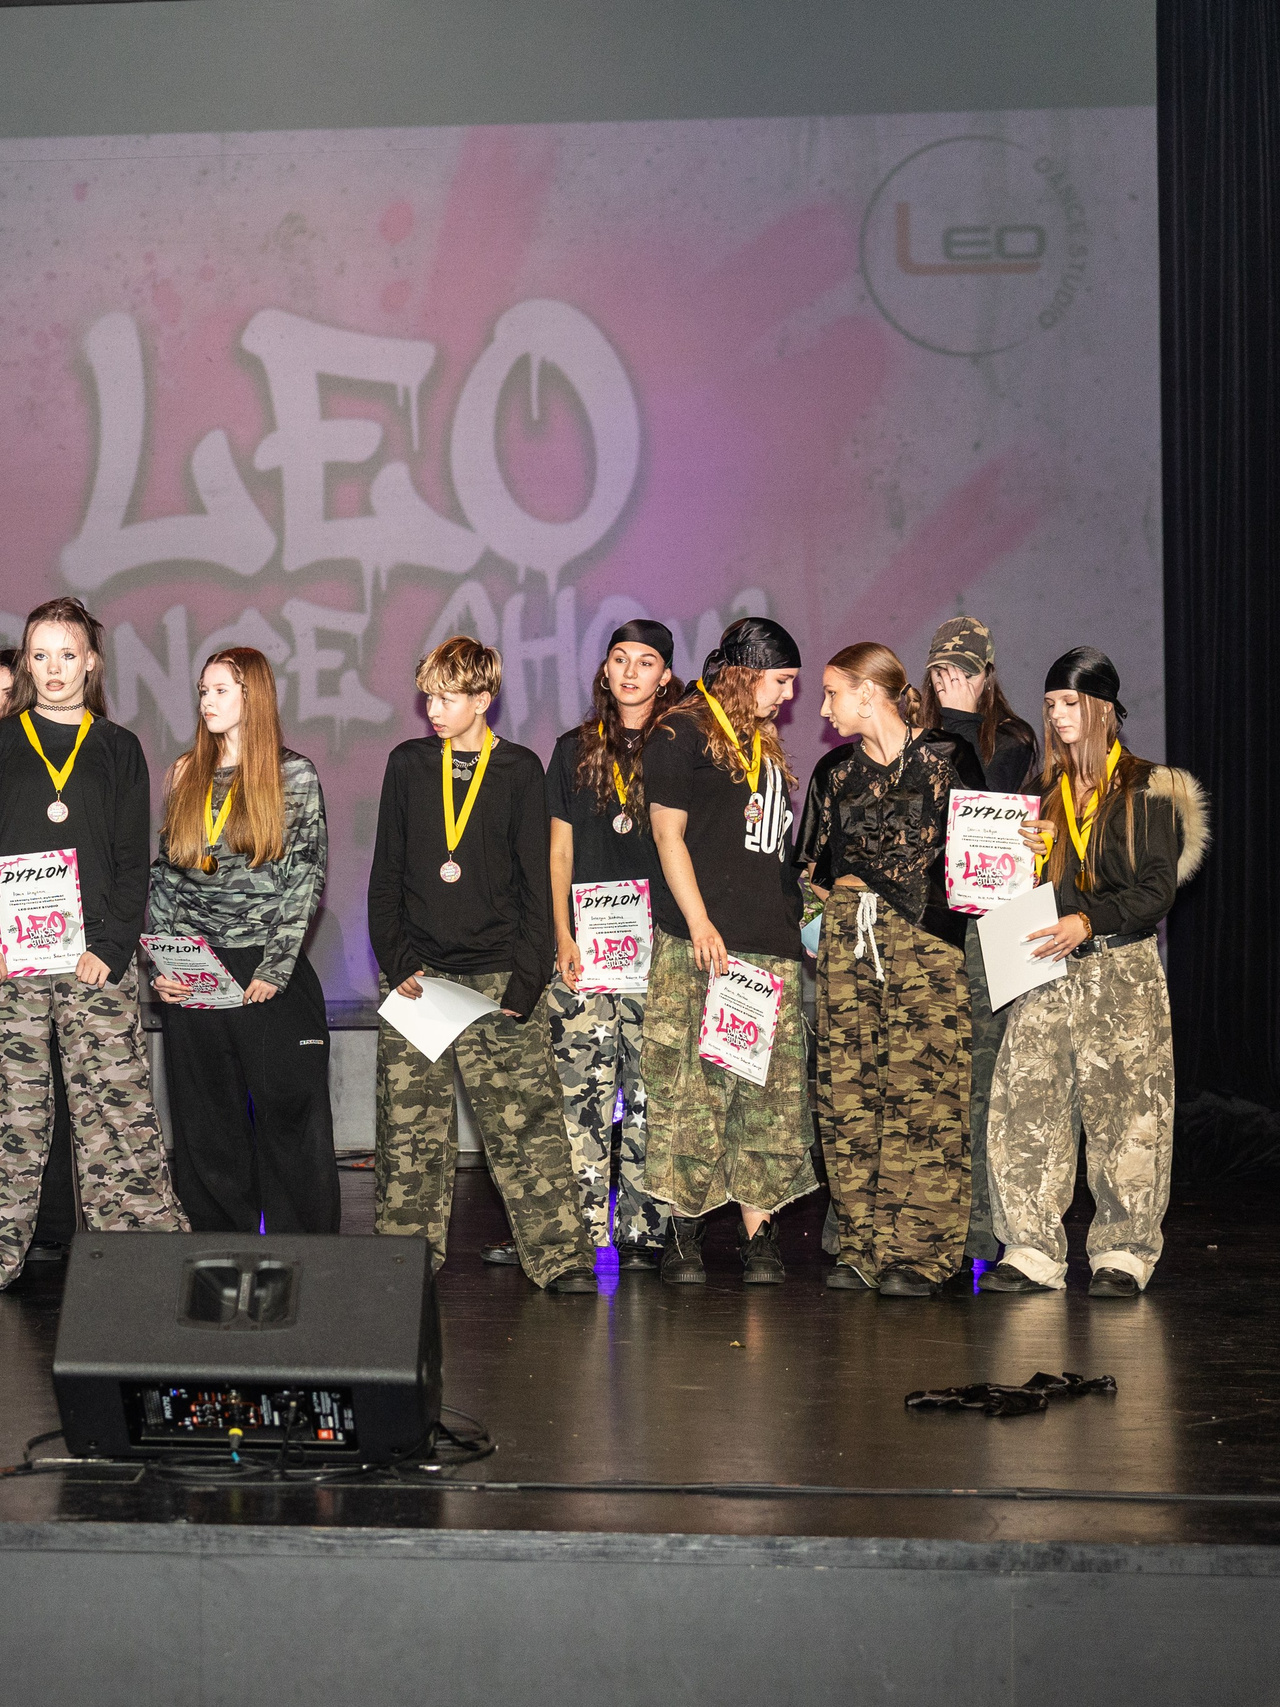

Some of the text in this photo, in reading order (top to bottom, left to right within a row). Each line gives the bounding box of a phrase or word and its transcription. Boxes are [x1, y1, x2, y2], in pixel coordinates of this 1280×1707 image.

[894, 201, 1047, 276] LEO
[60, 297, 642, 592] LEO
[958, 805, 1029, 821] DYPLOM
[1, 865, 68, 884] DYPLOM
[963, 851, 1015, 880] LEO
[582, 893, 641, 909] DYPLOM
[15, 911, 66, 943] LEO
[150, 943, 201, 953] DYPLOM
[593, 936, 638, 964] LEO
[720, 970, 774, 998] DYPLOM
[716, 1007, 758, 1046] LEO
